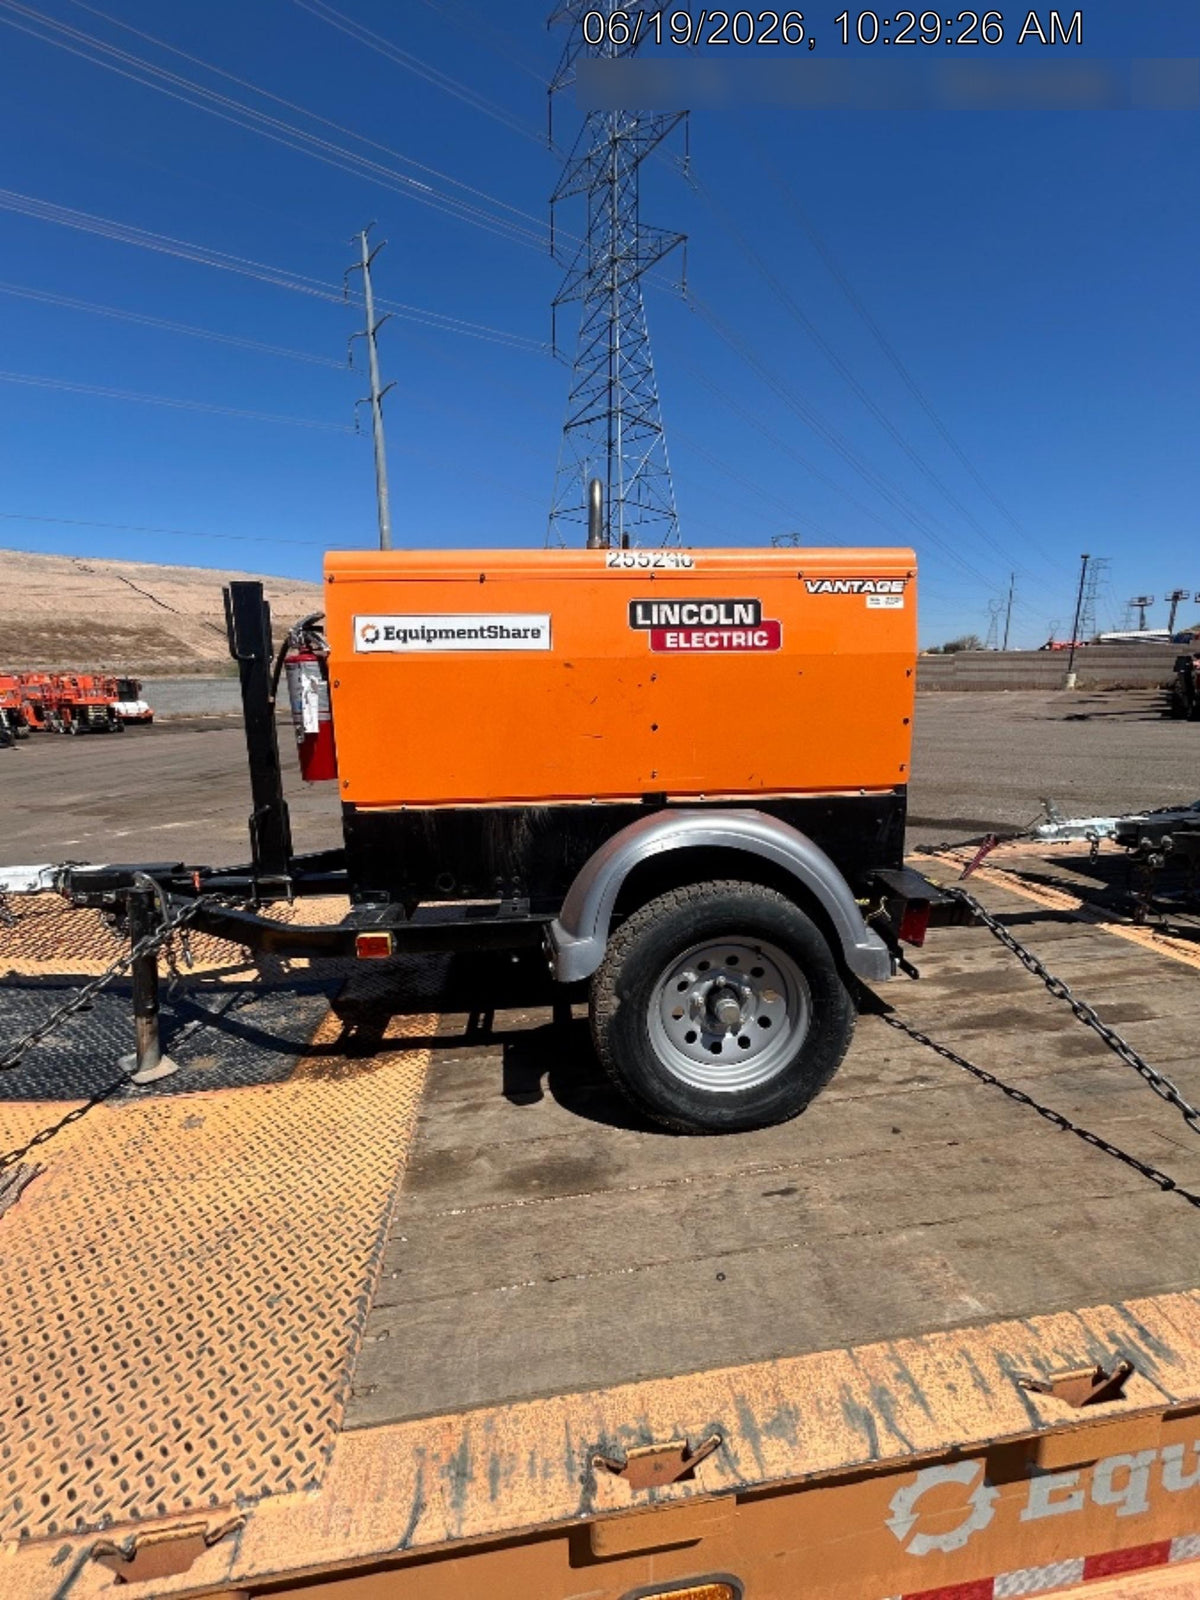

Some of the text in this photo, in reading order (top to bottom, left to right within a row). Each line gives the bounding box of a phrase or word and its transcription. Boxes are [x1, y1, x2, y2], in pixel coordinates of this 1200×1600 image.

[804, 579, 906, 595] VANTAGE
[635, 603, 755, 625] LINCOLN
[383, 624, 542, 643] EquipmentShare
[665, 630, 769, 649] ELECTRIC
